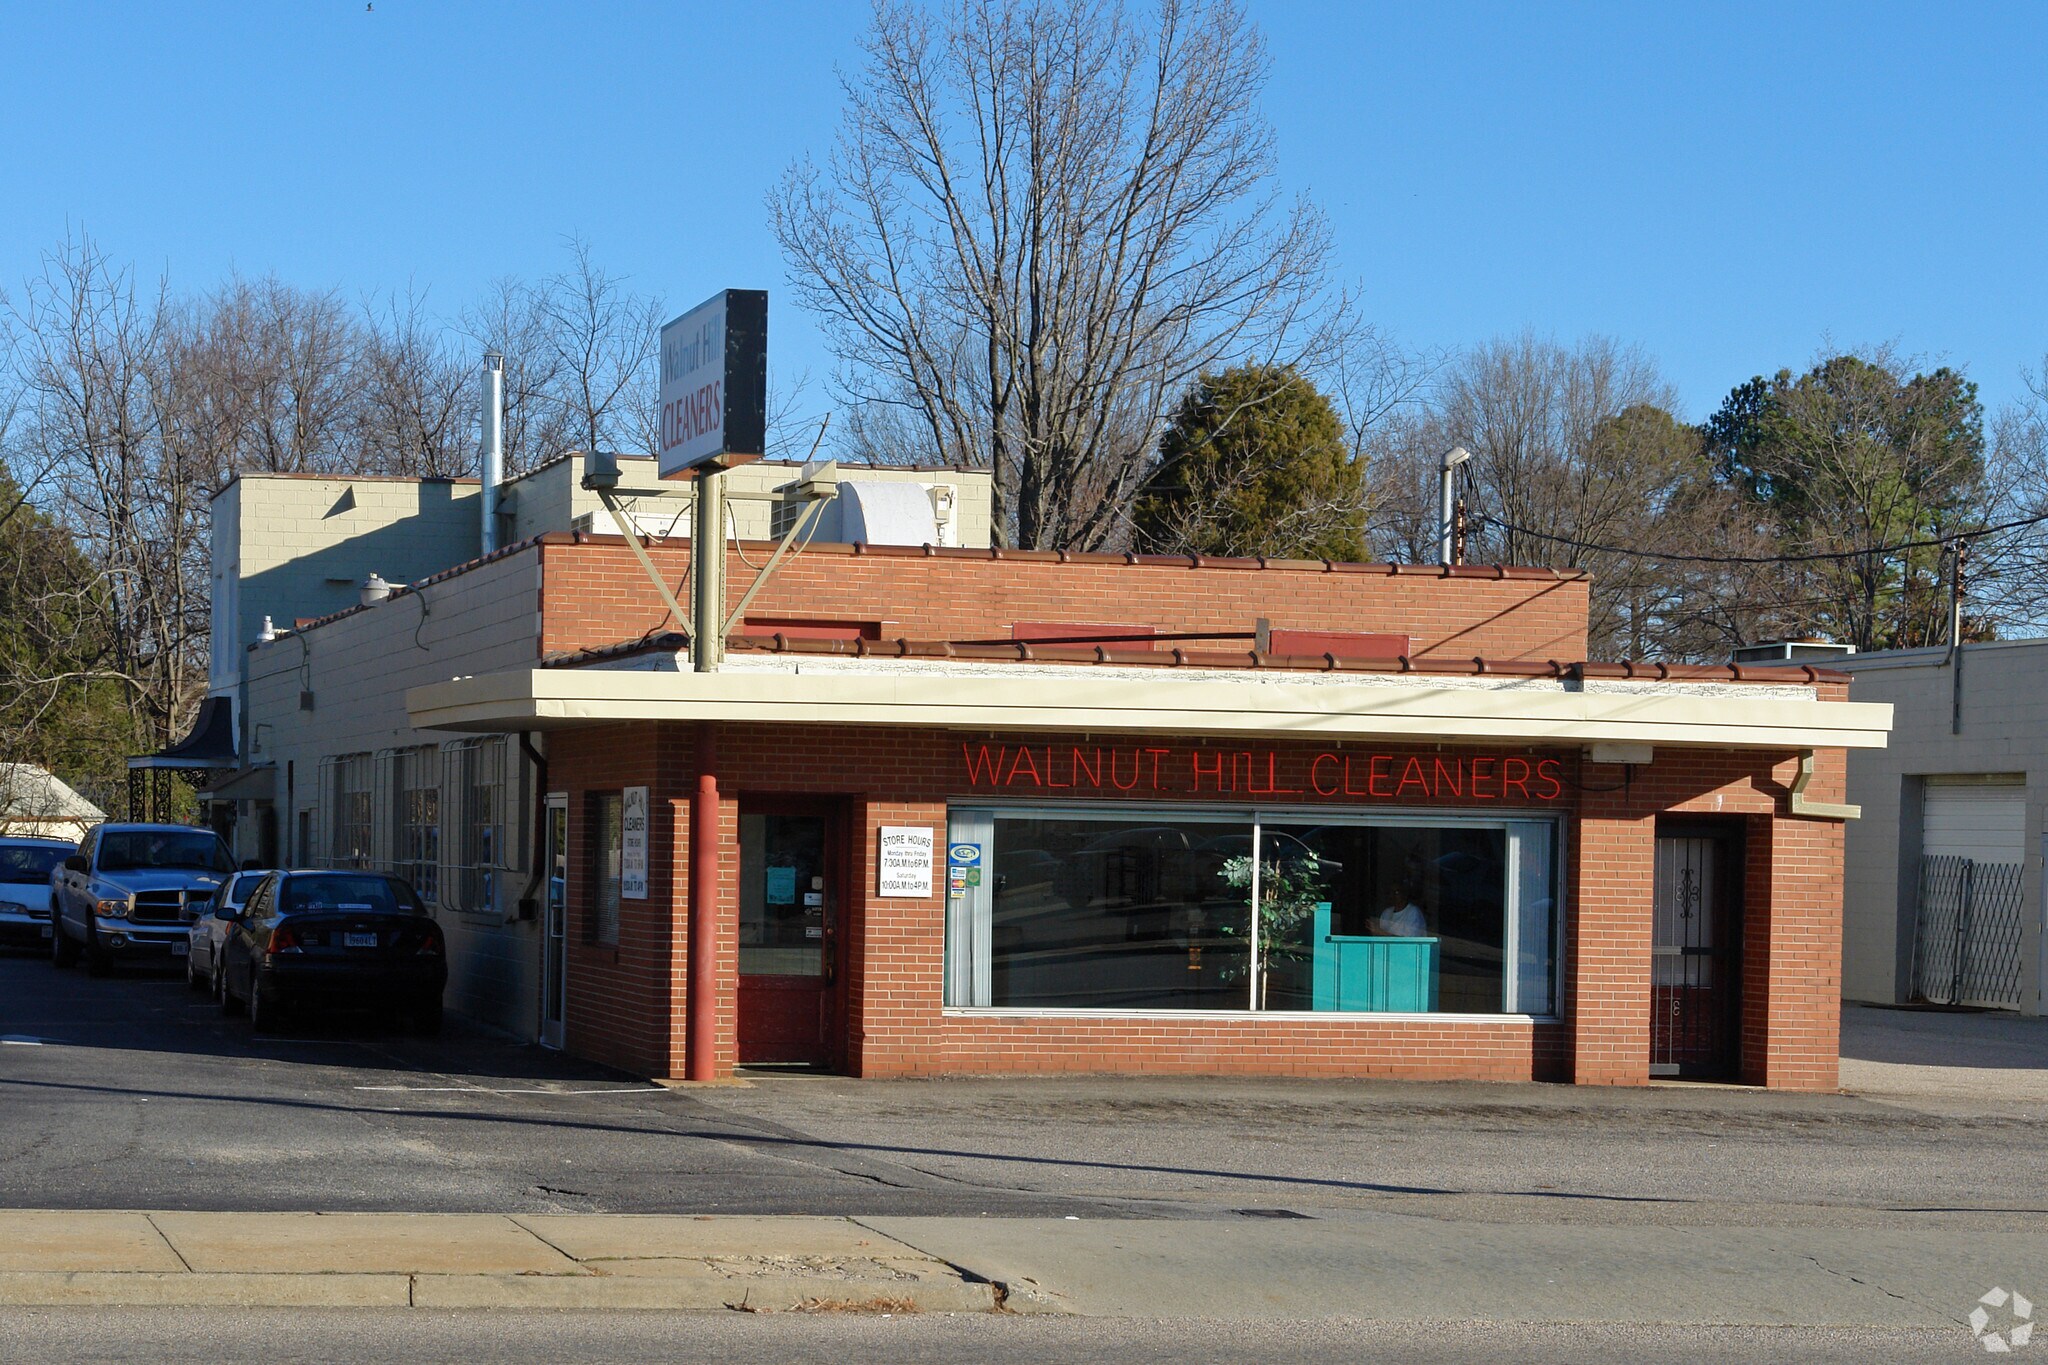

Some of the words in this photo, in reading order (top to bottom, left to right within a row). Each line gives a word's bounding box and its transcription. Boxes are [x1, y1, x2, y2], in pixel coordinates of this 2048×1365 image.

[664, 332, 700, 384] Walnut
[702, 313, 721, 366] Hill
[662, 379, 721, 452] CLEANERS
[963, 742, 1170, 789] WALNUT
[1190, 751, 1304, 794] HILL
[1311, 752, 1561, 800] CLEANERS
[882, 834, 905, 847] STORE
[908, 835, 932, 848] HOURS
